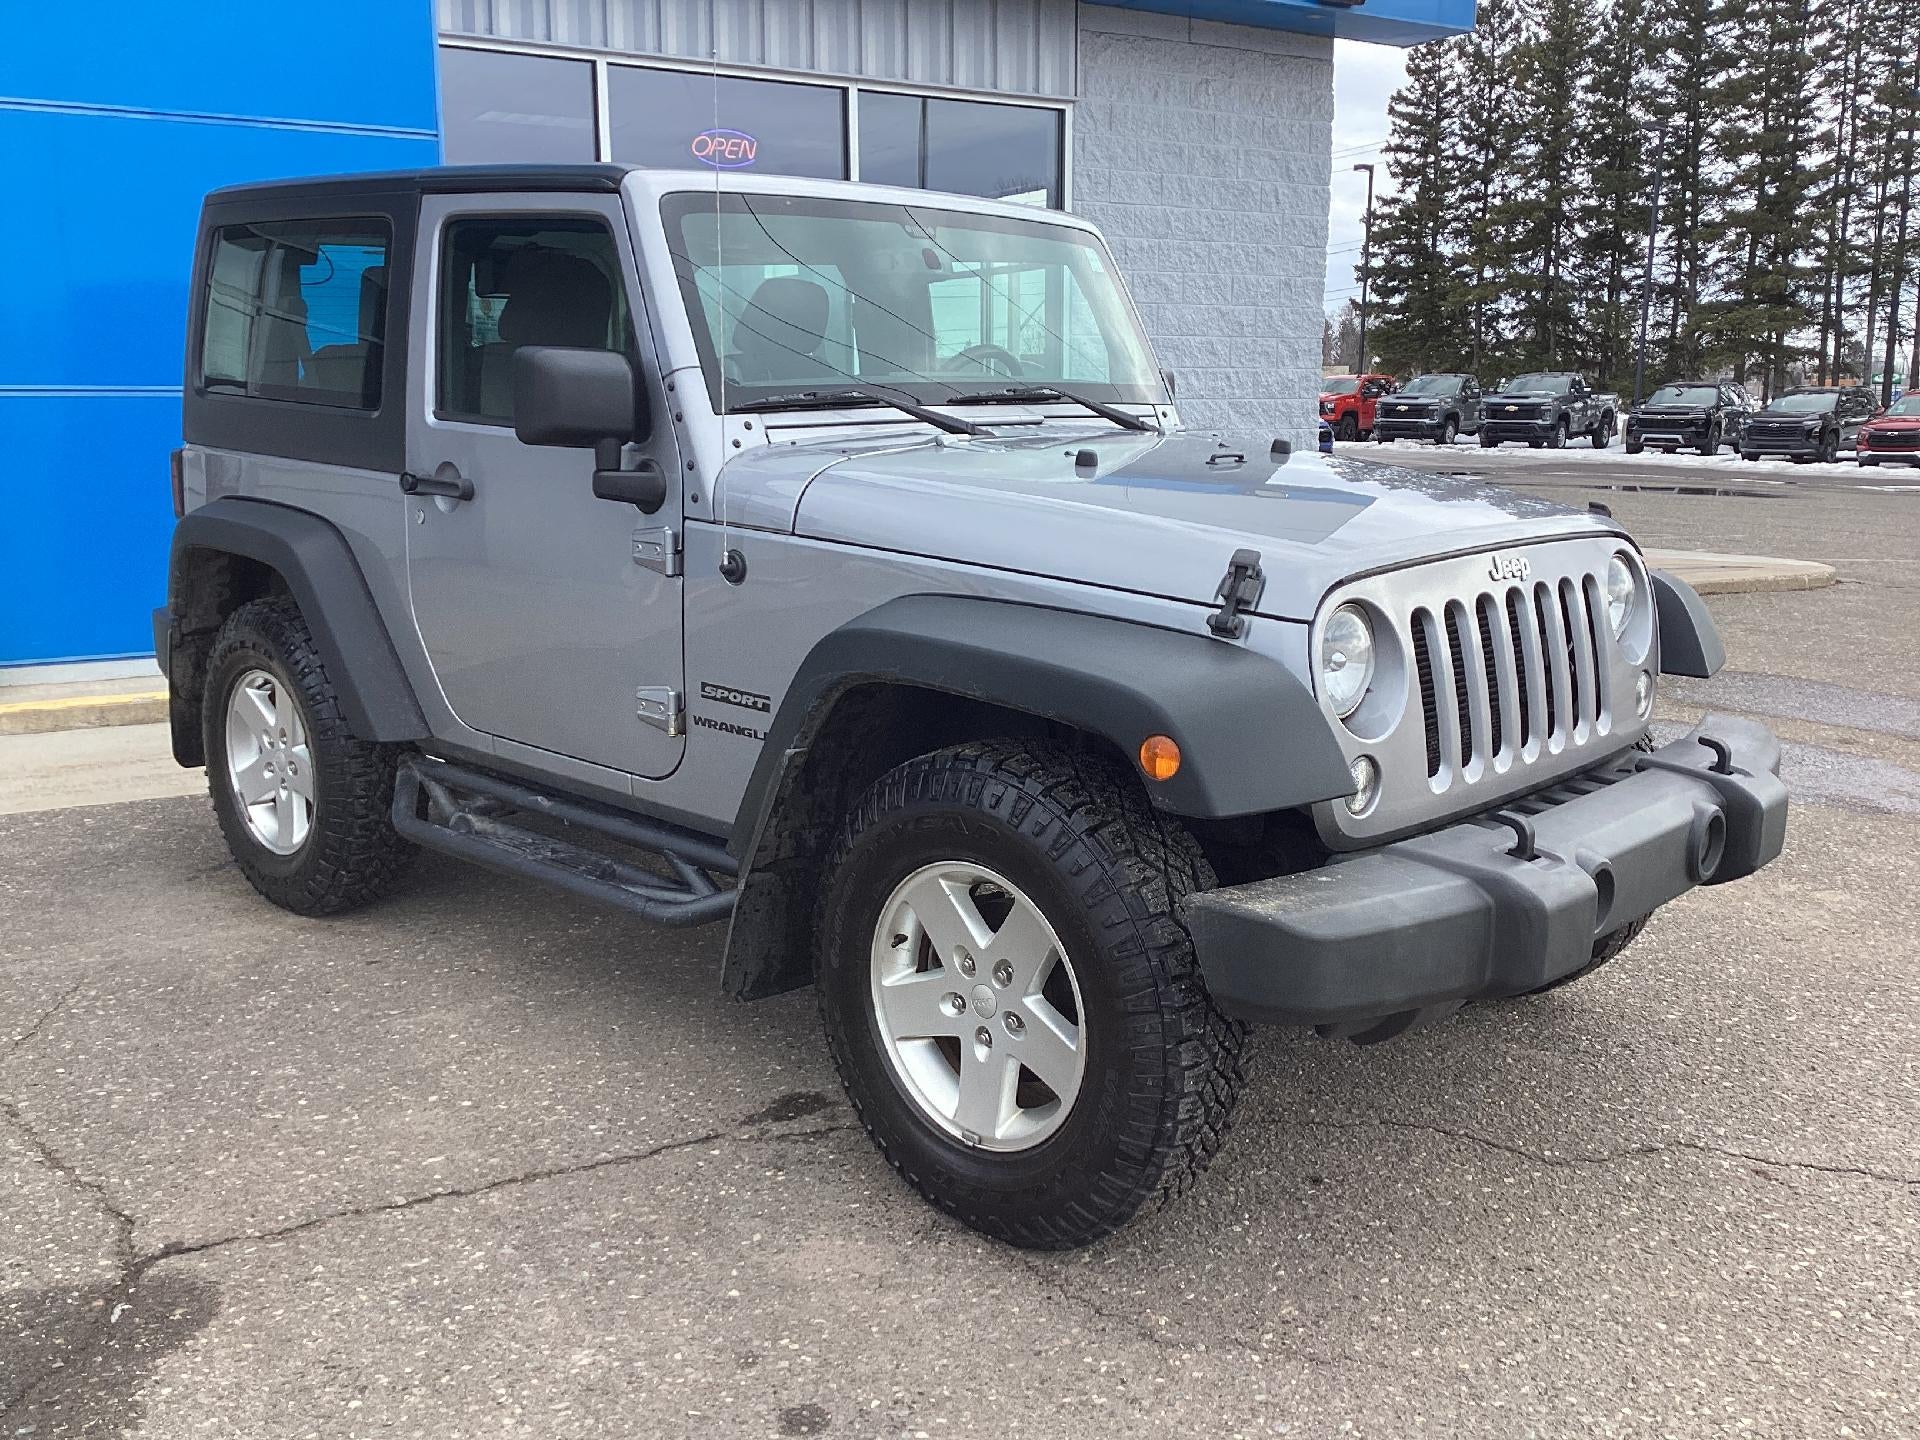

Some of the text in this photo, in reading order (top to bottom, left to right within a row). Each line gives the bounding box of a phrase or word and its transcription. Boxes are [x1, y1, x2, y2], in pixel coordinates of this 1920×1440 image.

[691, 135, 758, 160] OPEN
[1488, 555, 1531, 582] Jeep
[701, 685, 771, 709] SPORT
[692, 714, 769, 741] WRANGL
